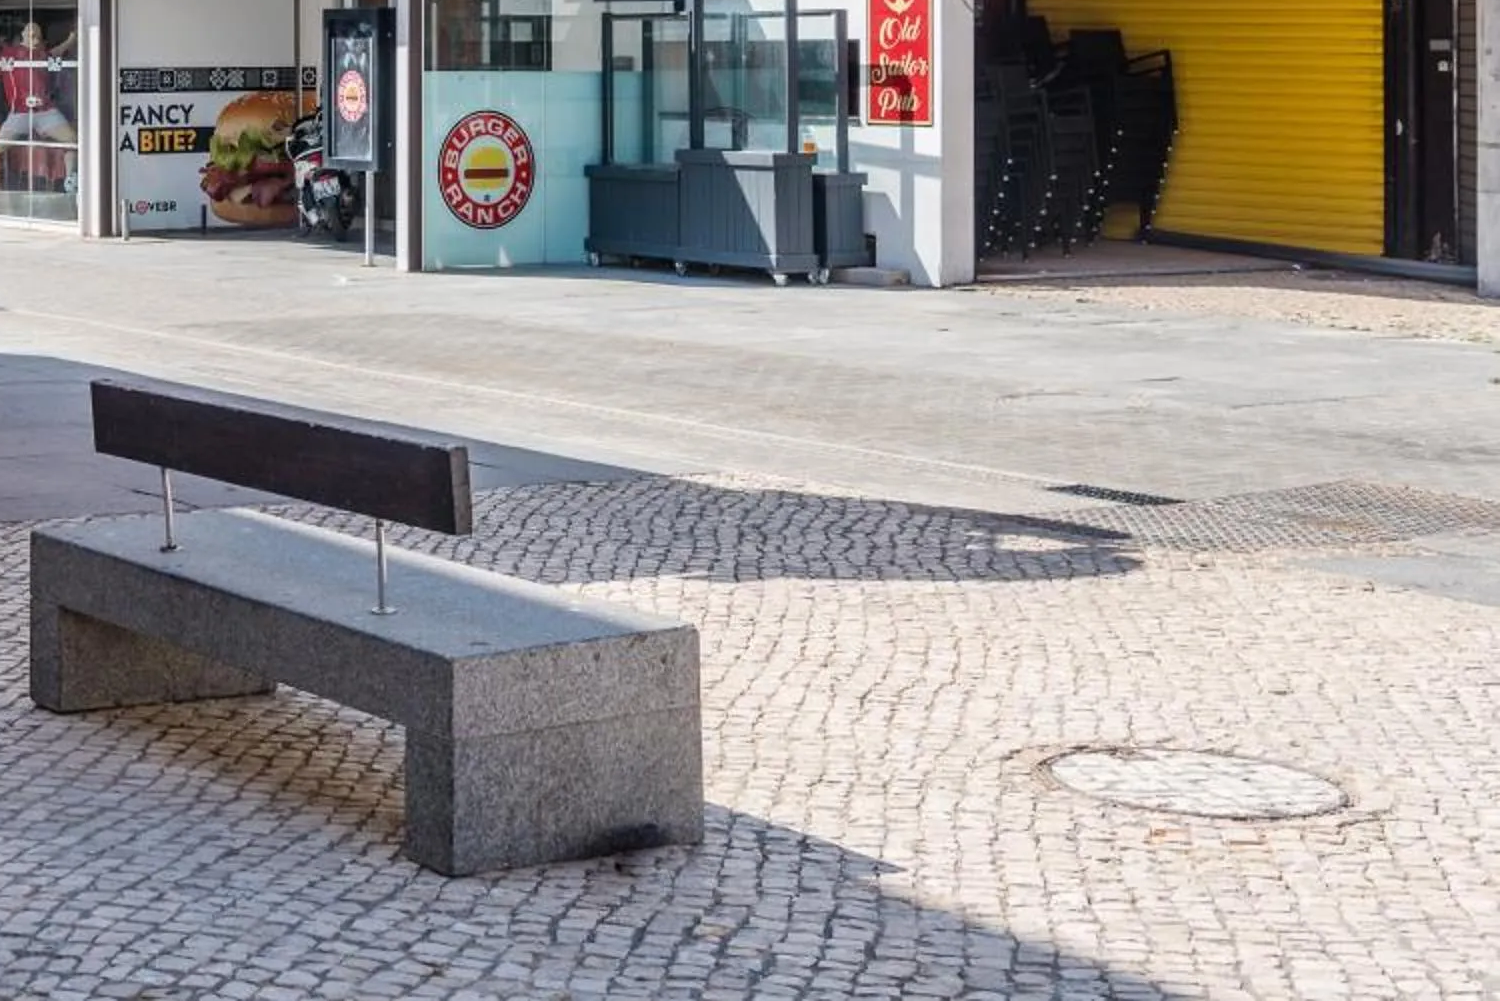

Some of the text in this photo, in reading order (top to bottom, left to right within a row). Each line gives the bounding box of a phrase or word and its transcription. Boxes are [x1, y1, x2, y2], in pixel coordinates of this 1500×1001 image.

[879, 14, 922, 50] Old
[871, 51, 929, 84] Sailor
[120, 104, 194, 125] FANCY
[877, 85, 922, 118] Pub
[120, 129, 197, 152] A BITE?
[444, 118, 528, 169] BURGER
[446, 182, 527, 224] RANCH
